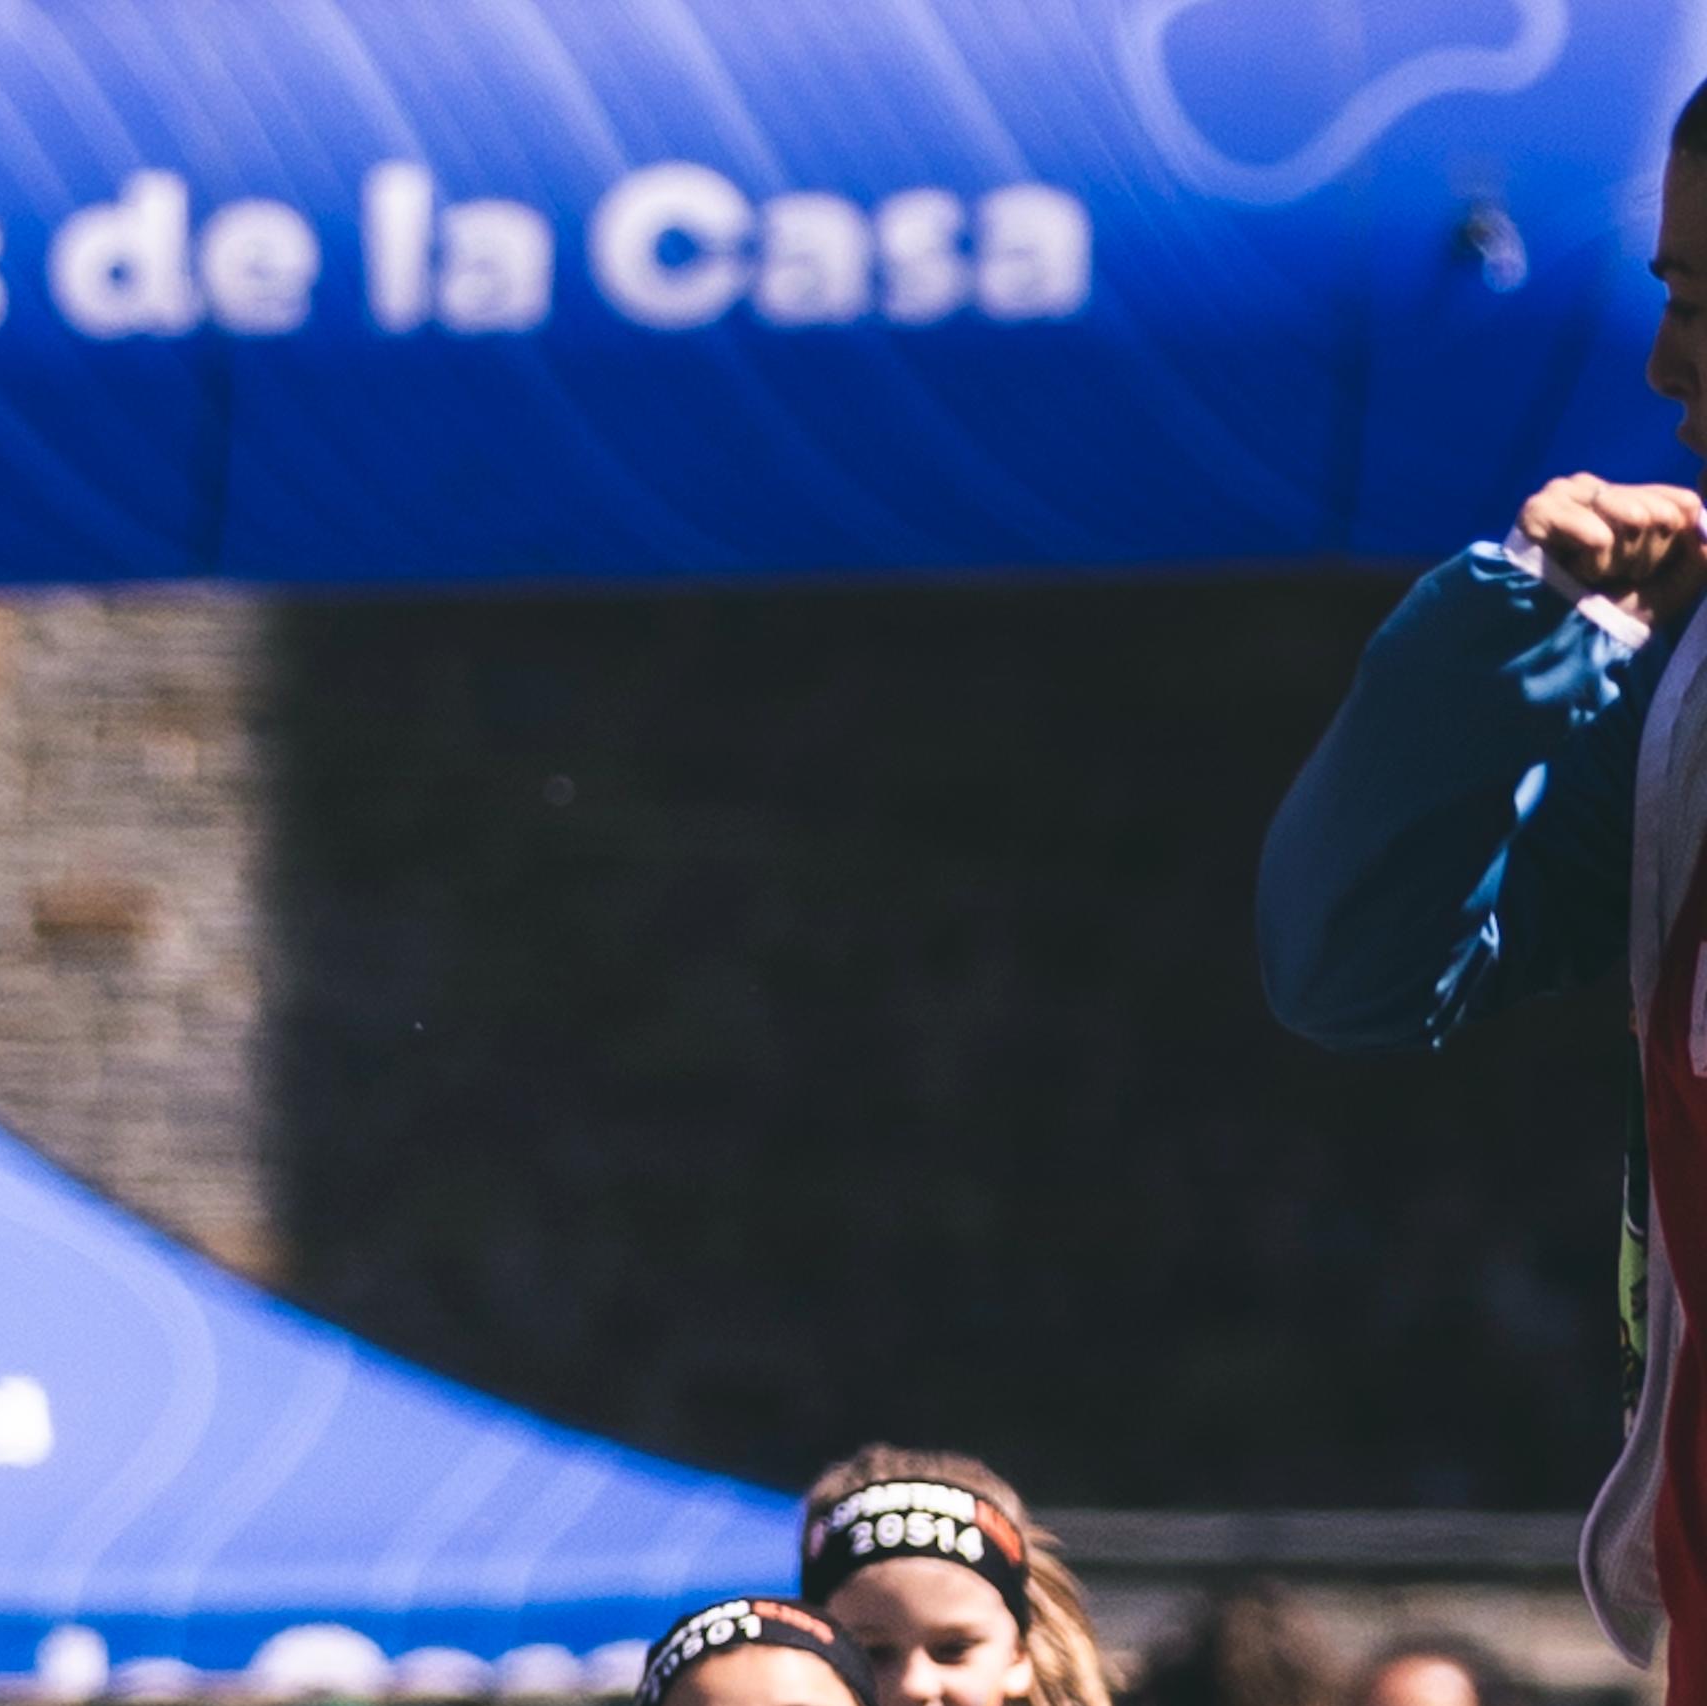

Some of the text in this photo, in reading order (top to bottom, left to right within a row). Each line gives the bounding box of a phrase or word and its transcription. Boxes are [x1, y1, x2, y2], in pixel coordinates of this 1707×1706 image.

[53, 169, 318, 336] de
[368, 164, 553, 333] la
[597, 164, 1085, 329] Casa
